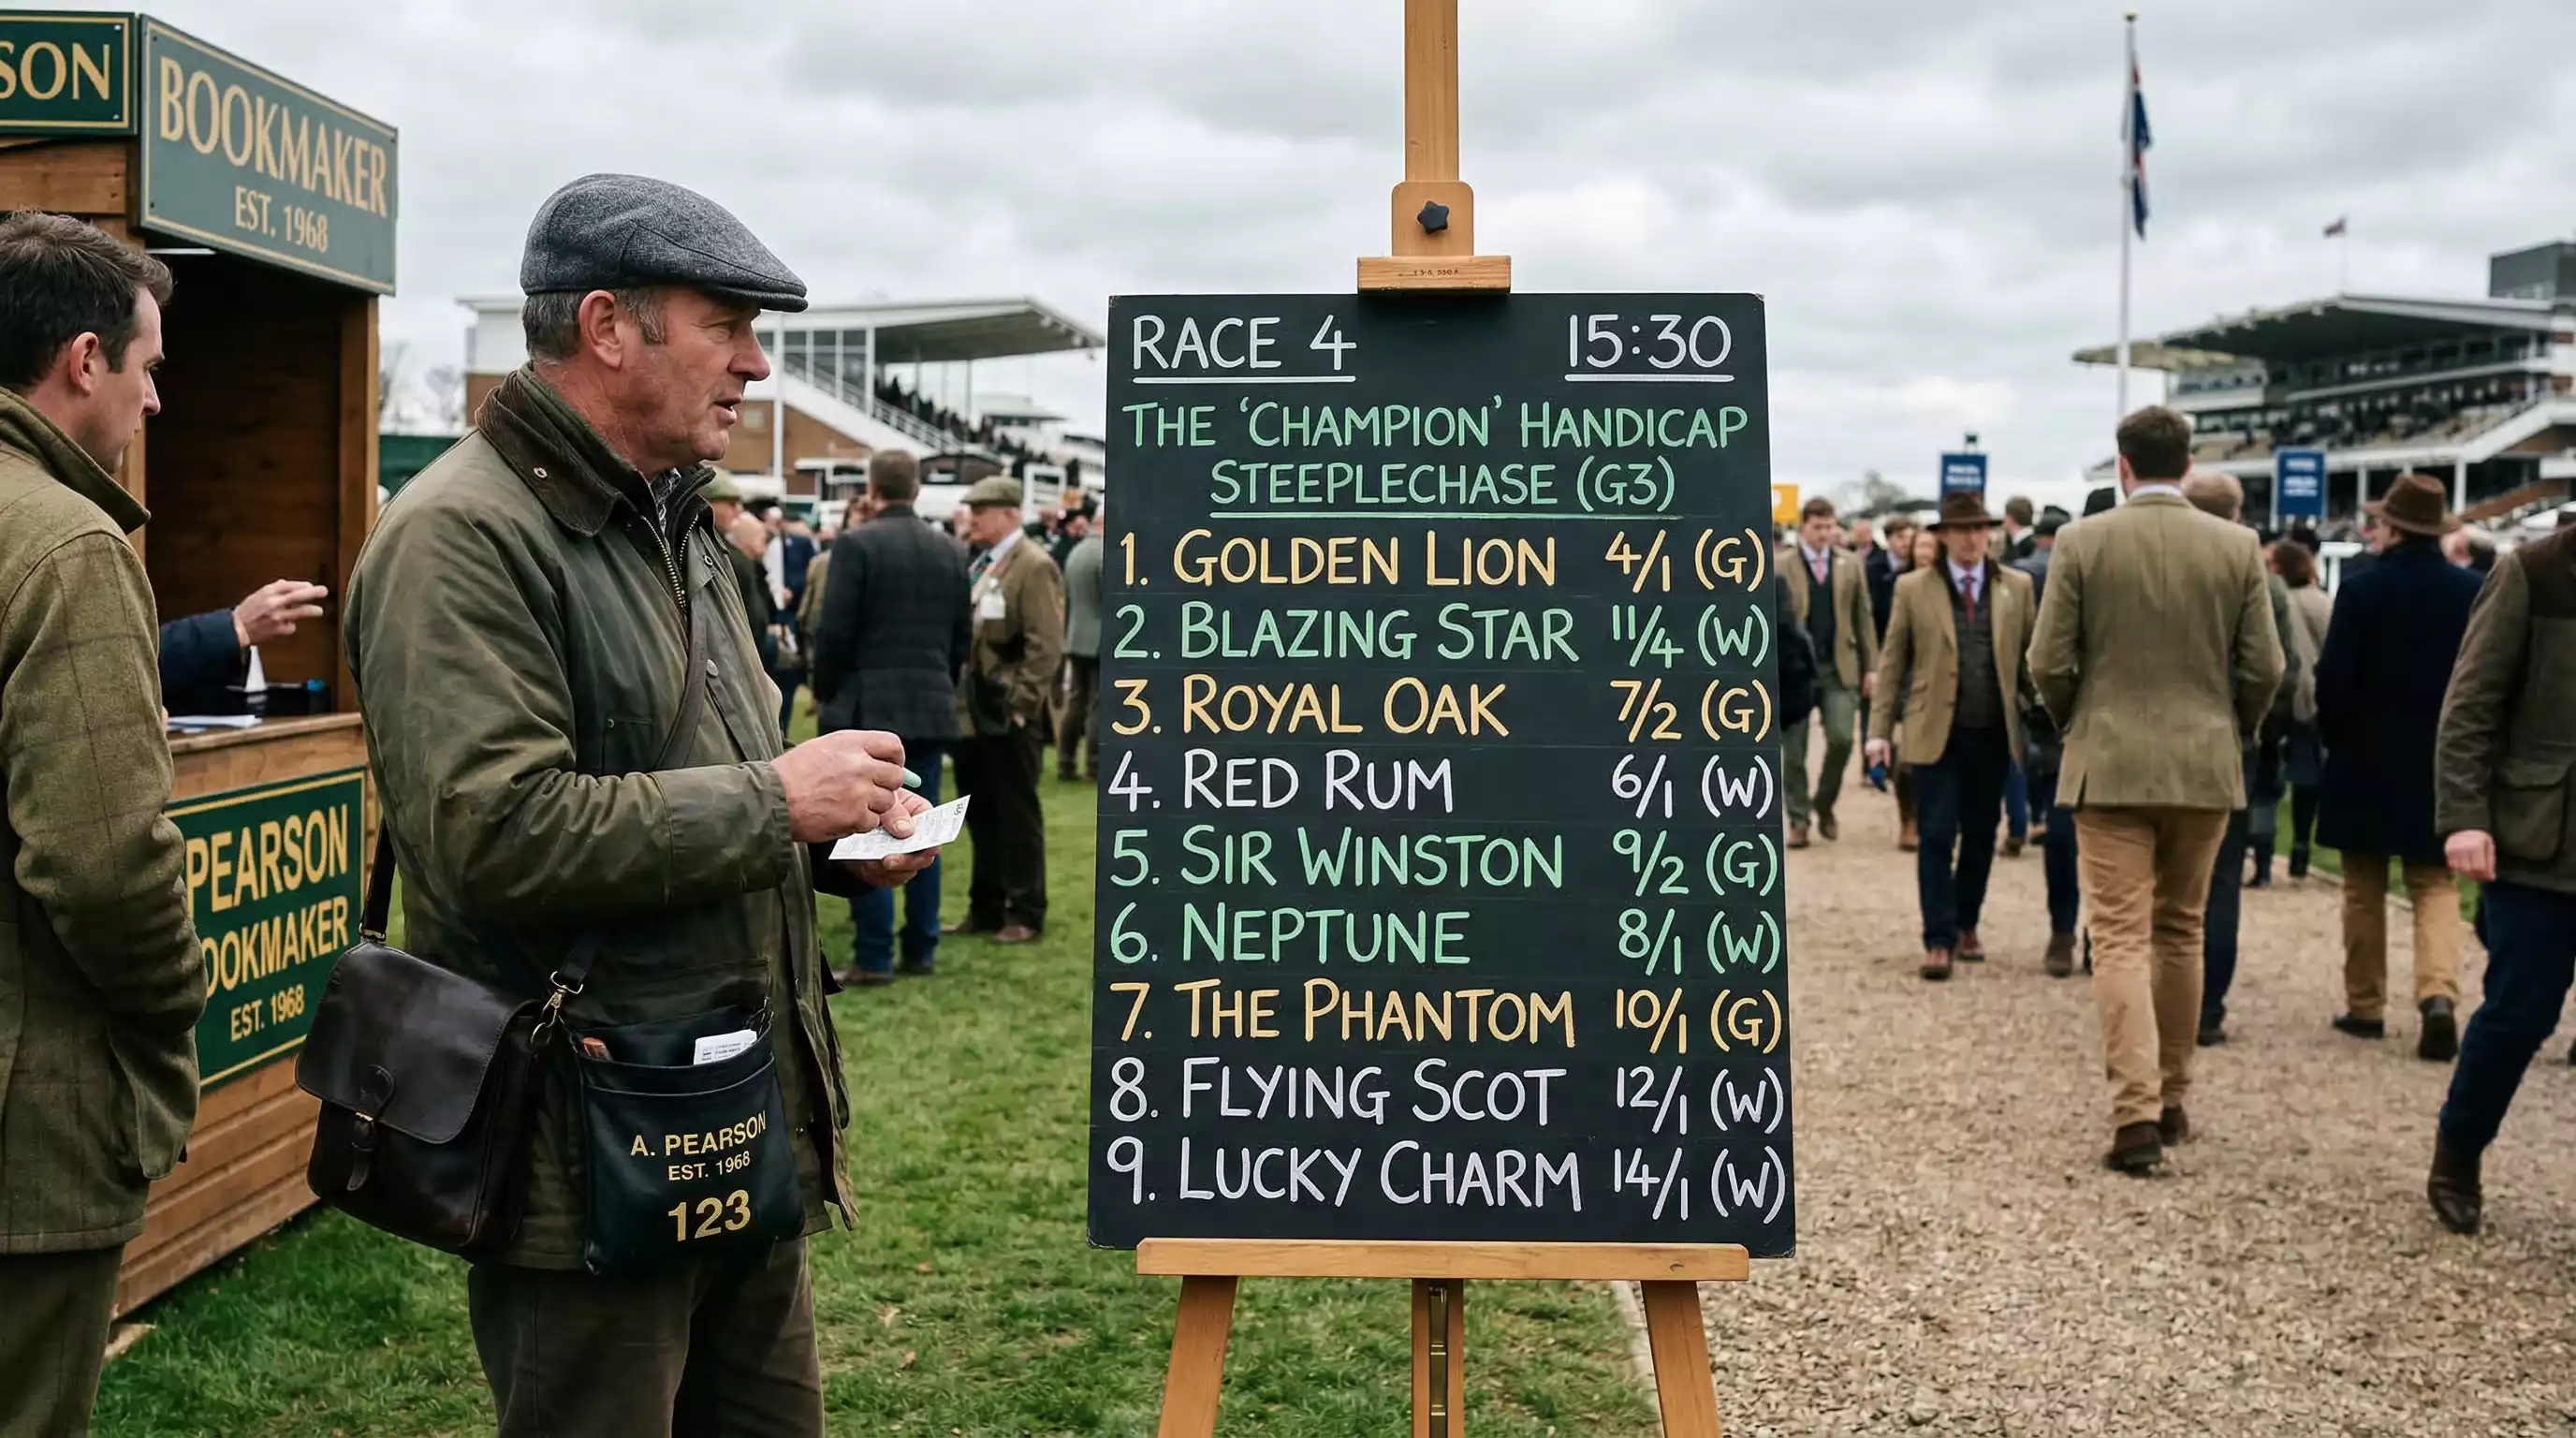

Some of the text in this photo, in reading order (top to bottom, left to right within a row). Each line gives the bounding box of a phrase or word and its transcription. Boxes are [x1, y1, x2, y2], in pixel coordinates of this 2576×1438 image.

[159, 55, 388, 218] BOOKMAKER
[233, 184, 329, 254] EST. 1968
[1134, 314, 1357, 371] RACE 4
[1569, 314, 1732, 369] 15:30
[1122, 403, 1216, 448] THE
[1521, 402, 1749, 448] HANDICAP
[1210, 455, 1675, 512] STEEPLECHASE (G3)
[1120, 527, 1765, 593] 1. GOLDEN LION 4/1 (G)
[1113, 600, 1770, 669] 2. BLAZING STAR 11/4 (W)
[1111, 673, 1772, 743] 3. ROYAL OAK 7/2 (G)
[1108, 748, 1774, 820] 4. RED RUM 6/1 (W)
[185, 802, 348, 921] PEARSON
[1110, 824, 1778, 897] 5. SIR WINSTON 9/2 (G)
[1110, 902, 1780, 976] 6. NEPTUNE 8/1 (W)
[230, 983, 305, 1043] EST. 1968
[1109, 977, 1782, 1054] 7. THE PHANTOM 10/1 (G)
[1109, 1056, 1784, 1136] 8. FLYING SCOT 12/1 (W)
[630, 1109, 767, 1157] A. PEARSON
[667, 1151, 751, 1181] EST. 1968
[667, 1188, 752, 1242] 123
[1106, 1136, 1786, 1225] 9. LUCKY CHARM 14/1 (W)
